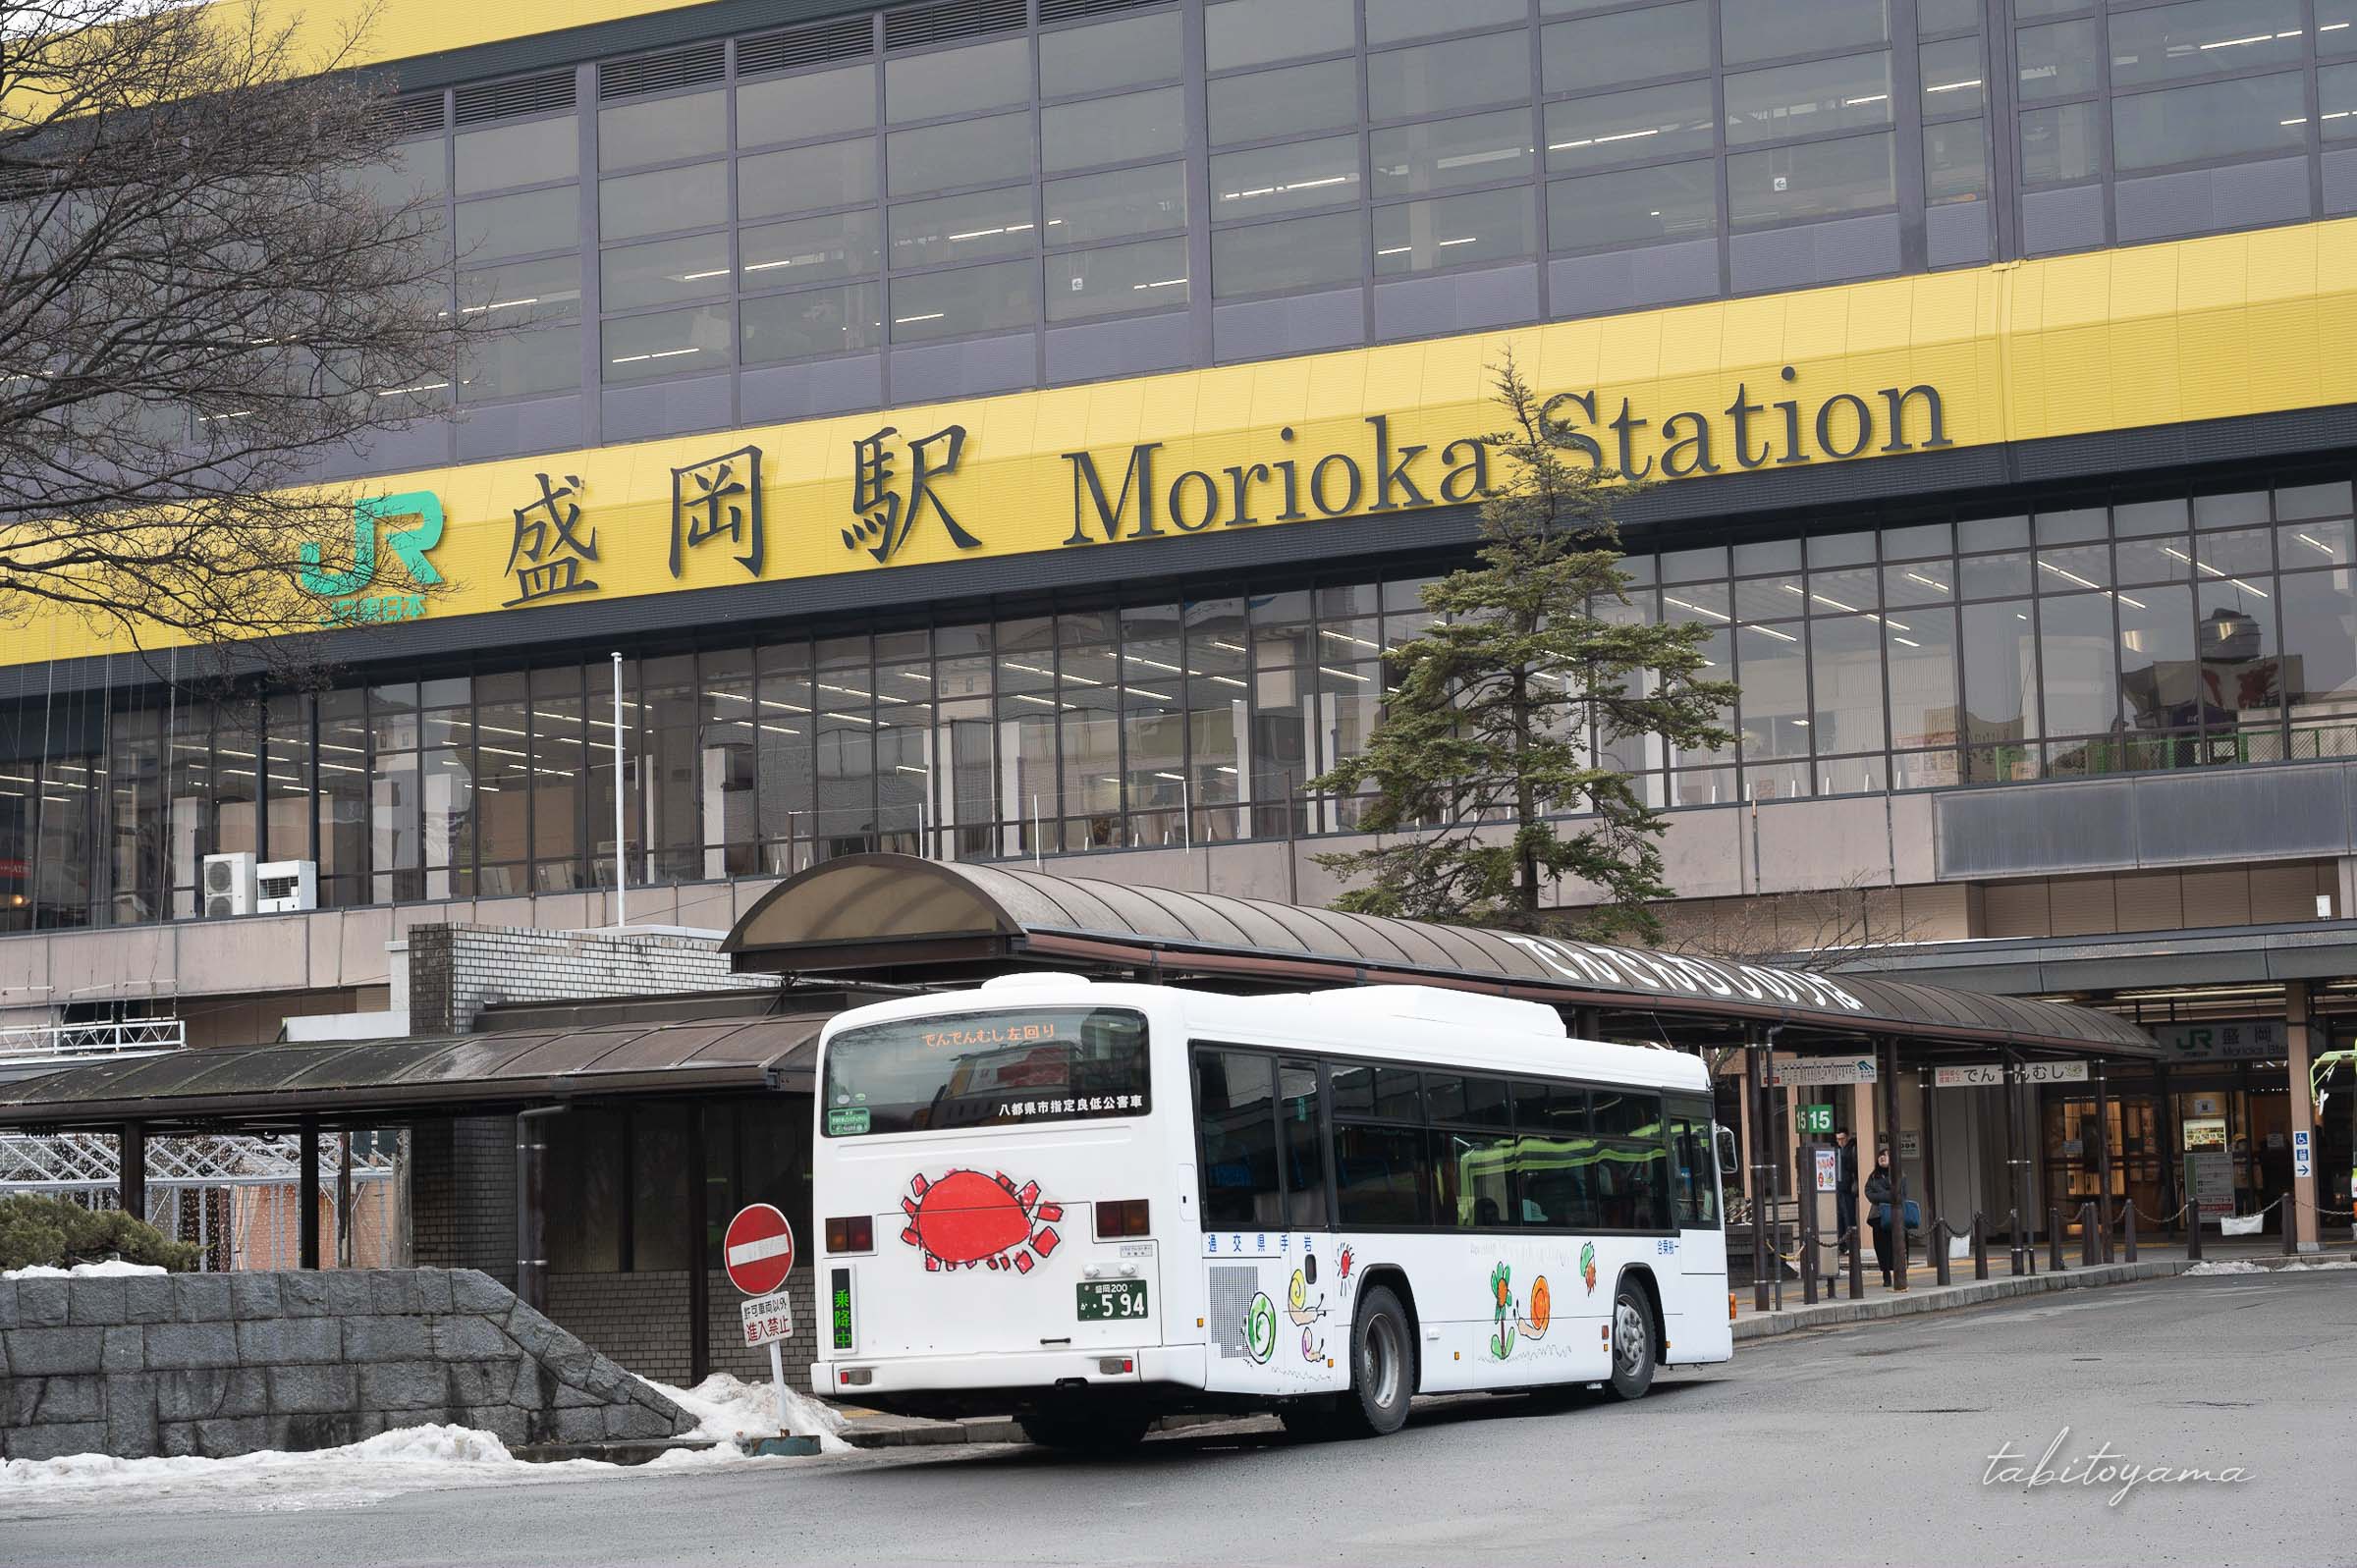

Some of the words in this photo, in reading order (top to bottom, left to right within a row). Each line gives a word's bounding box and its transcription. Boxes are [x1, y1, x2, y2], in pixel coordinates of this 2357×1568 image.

[1061, 416, 1490, 546] Morioka
[1539, 366, 1953, 480] Station
[501, 425, 982, 608] 盛岡駅
[300, 491, 444, 596] JR
[999, 1095, 1143, 1116] 八都県市指定良低公害車
[1809, 1110, 1831, 1129] 15
[743, 1297, 787, 1320] 許可車両以外
[745, 1315, 791, 1343] 進入禁止
[835, 1289, 851, 1348] 乗降中
